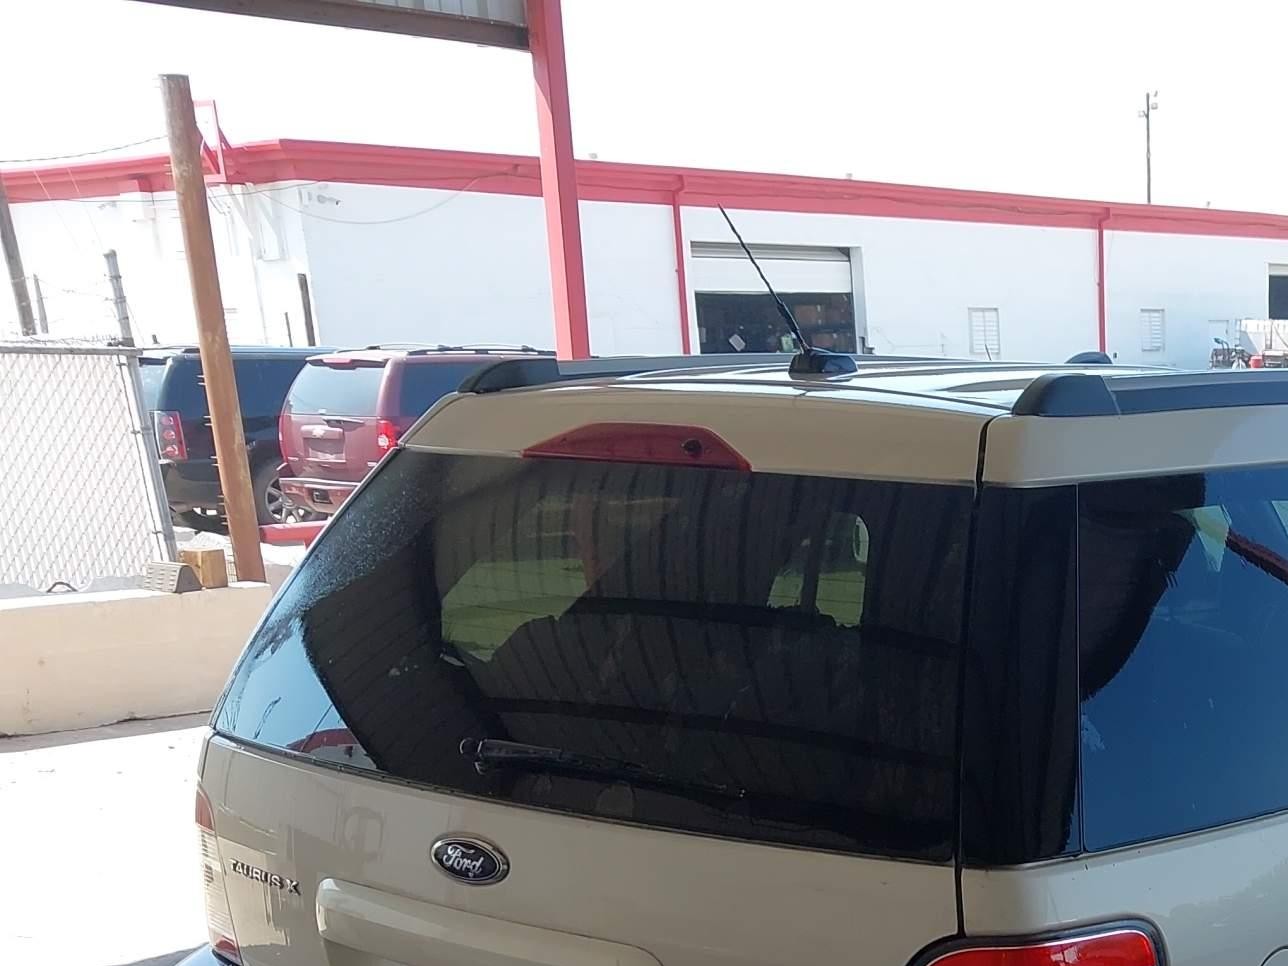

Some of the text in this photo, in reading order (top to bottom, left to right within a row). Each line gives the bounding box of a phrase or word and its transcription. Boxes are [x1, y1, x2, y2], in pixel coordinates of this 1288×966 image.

[443, 844, 485, 874] Ford
[229, 858, 301, 896] TAURUS X
